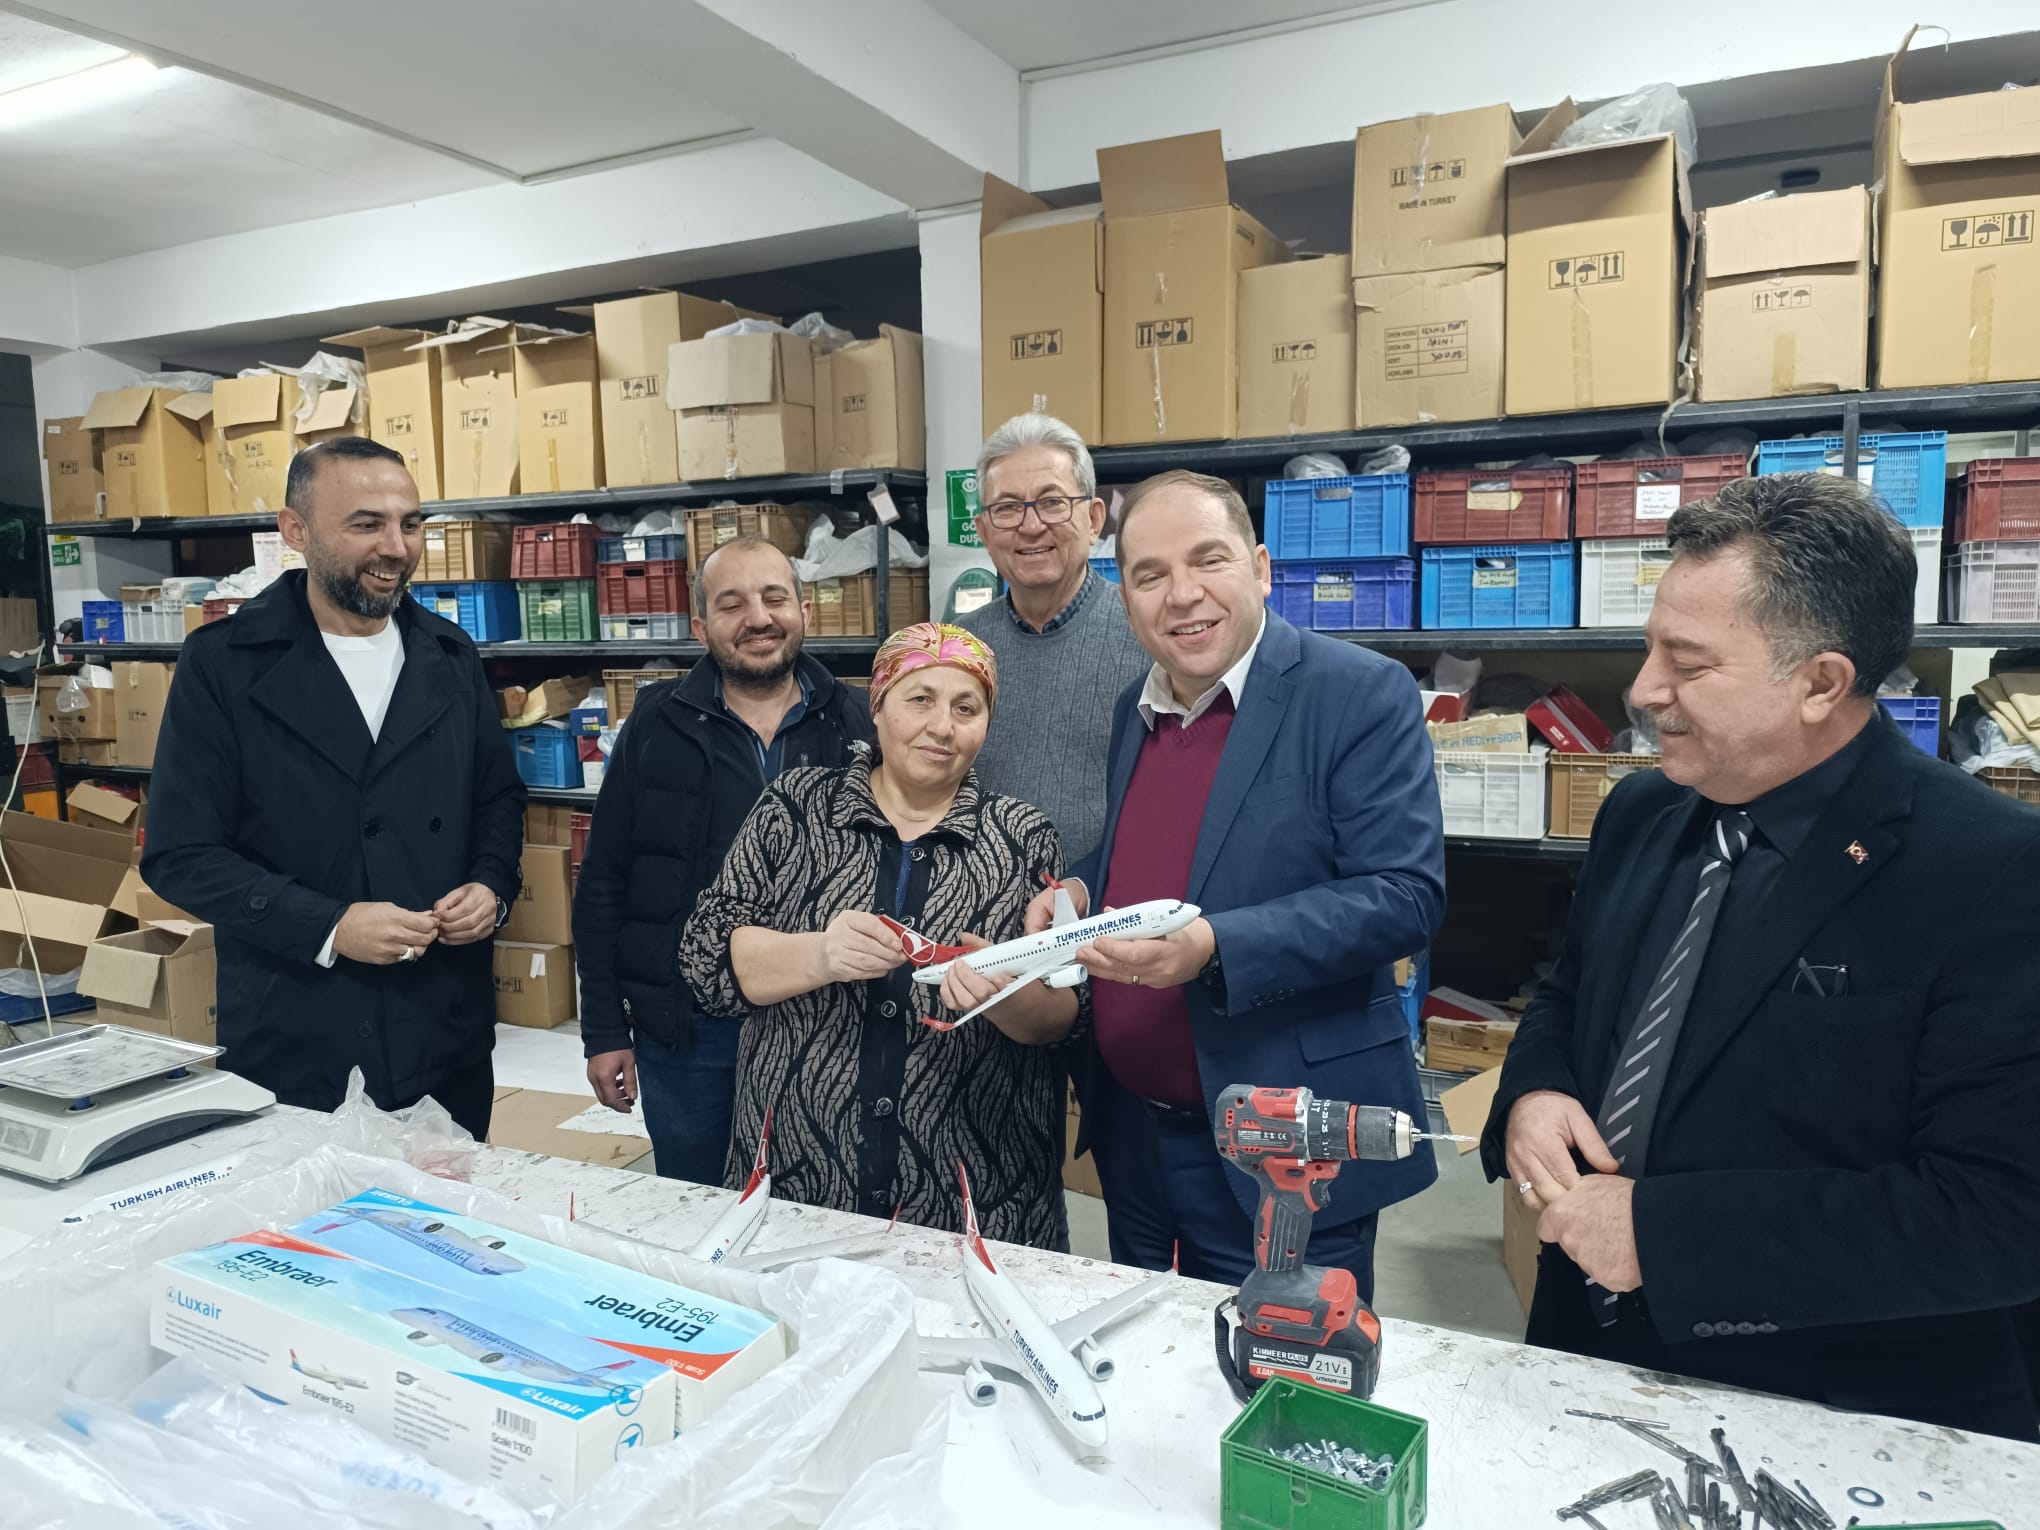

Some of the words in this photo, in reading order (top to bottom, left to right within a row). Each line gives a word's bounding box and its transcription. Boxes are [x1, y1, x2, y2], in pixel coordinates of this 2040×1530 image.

[1429, 196, 1456, 206] TURKEY
[961, 519, 977, 531] GÖ
[960, 533, 983, 547] DUŞ
[1055, 925, 1097, 943] TURKISH
[1097, 913, 1142, 932] AIRLINES
[110, 1187, 163, 1211] TURKISH
[165, 1170, 216, 1193] AIRLINES
[214, 1260, 269, 1282] 195-E2
[234, 1249, 339, 1288] Embraer
[177, 1290, 222, 1320] Luxair
[656, 1297, 719, 1325] 195-E2
[584, 1294, 705, 1343] Embraer
[1013, 1329, 1036, 1362] TURKISH
[1032, 1358, 1059, 1394] AIRLINES
[1315, 1360, 1341, 1374] 21V
[531, 1391, 585, 1416] Luxair
[491, 1432, 512, 1449] Scale
